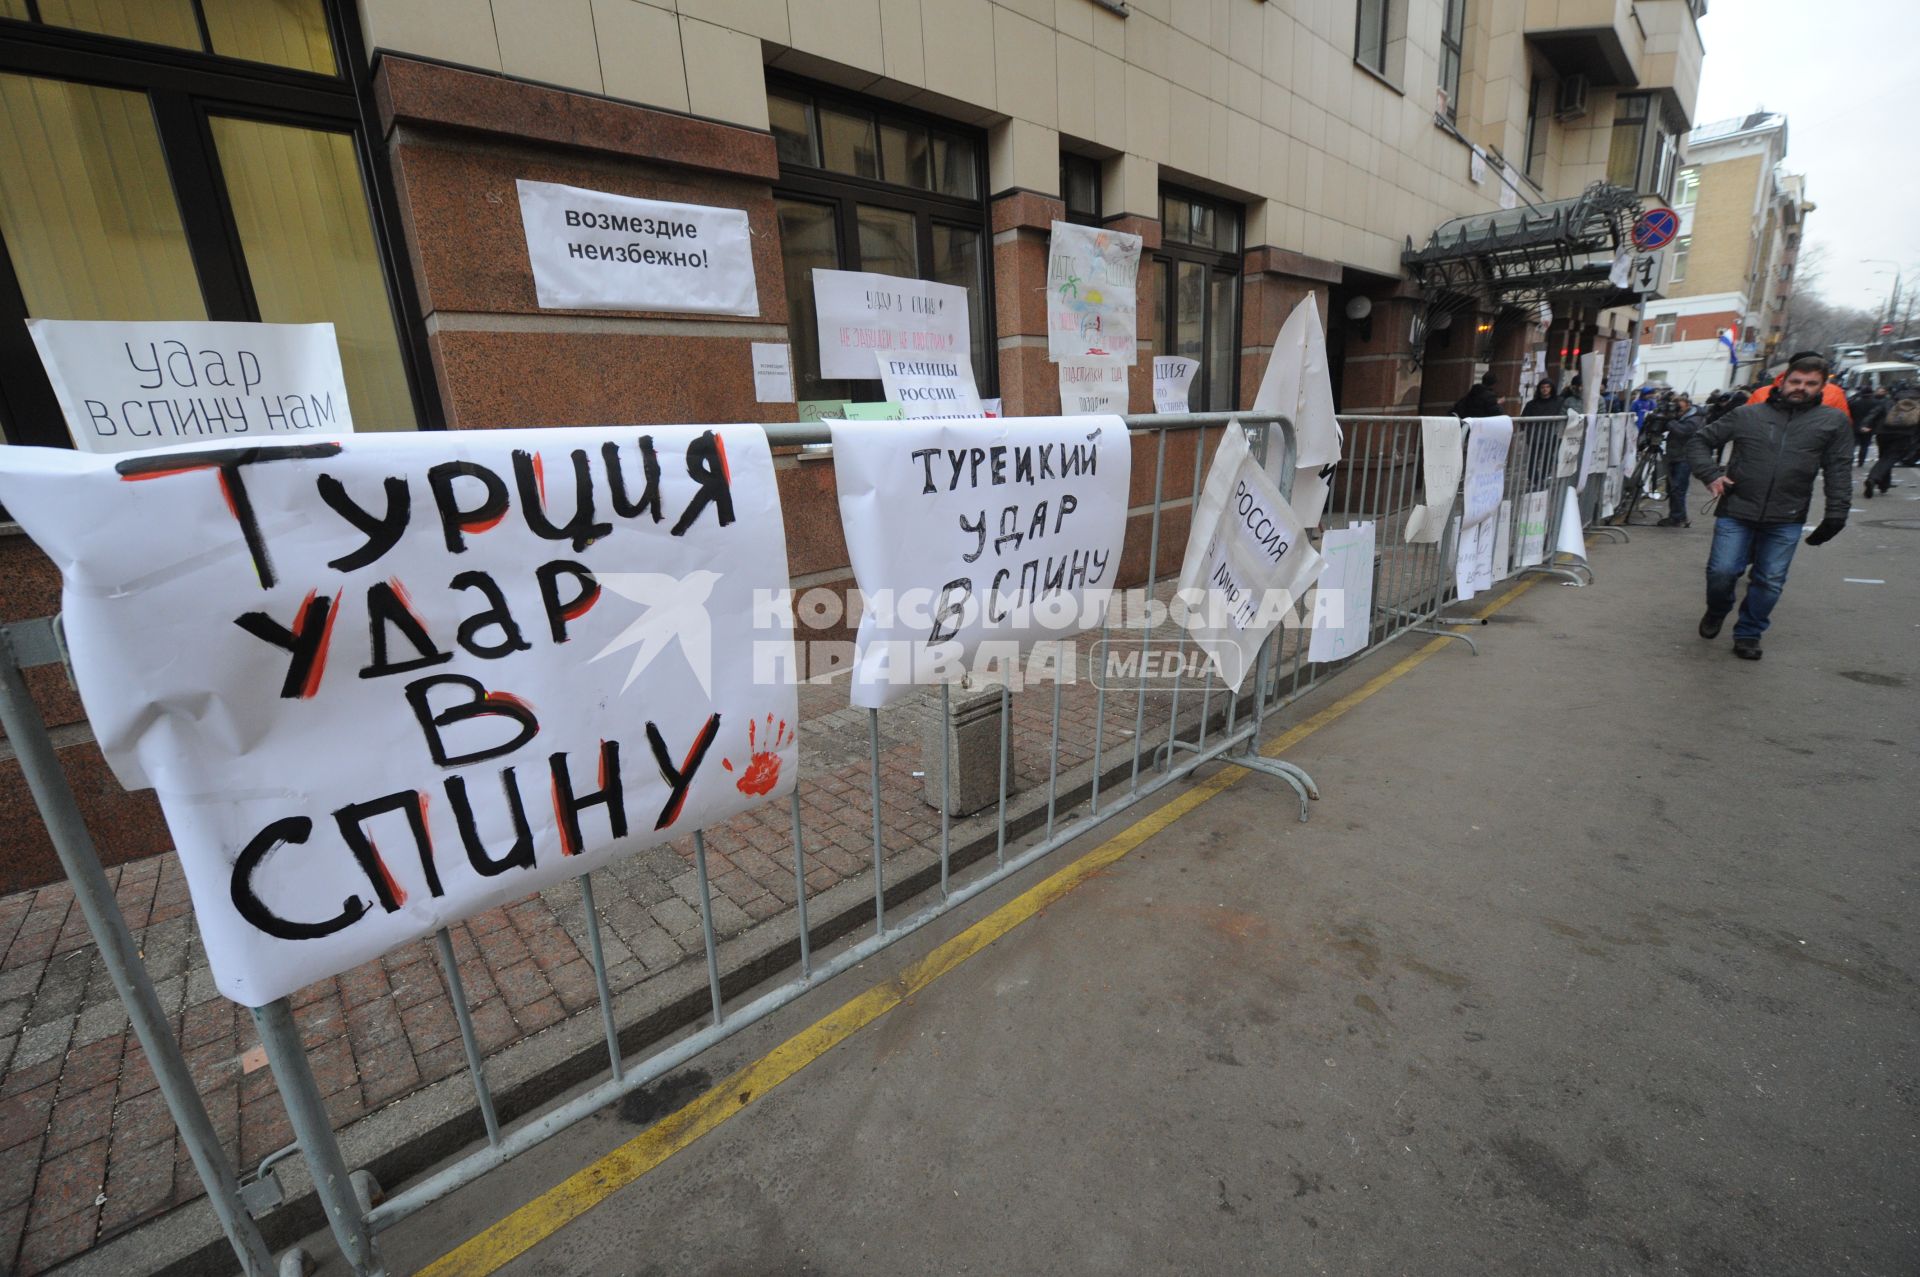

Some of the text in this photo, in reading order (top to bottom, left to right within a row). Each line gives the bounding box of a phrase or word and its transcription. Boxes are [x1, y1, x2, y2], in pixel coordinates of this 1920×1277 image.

[567, 242, 709, 269] неизбежно!
[889, 360, 959, 378] ГРАНИЦЫ
[911, 427, 1102, 495] ТУРЕЦКИЙ
[115, 430, 737, 590] ТУРЦИЯ
[959, 494, 1078, 563] УДАР
[1234, 480, 1289, 563] РОССИЯ
[925, 548, 1110, 652] В СПИНУ
[404, 673, 540, 769] В
[230, 712, 723, 941] СПИНУ
